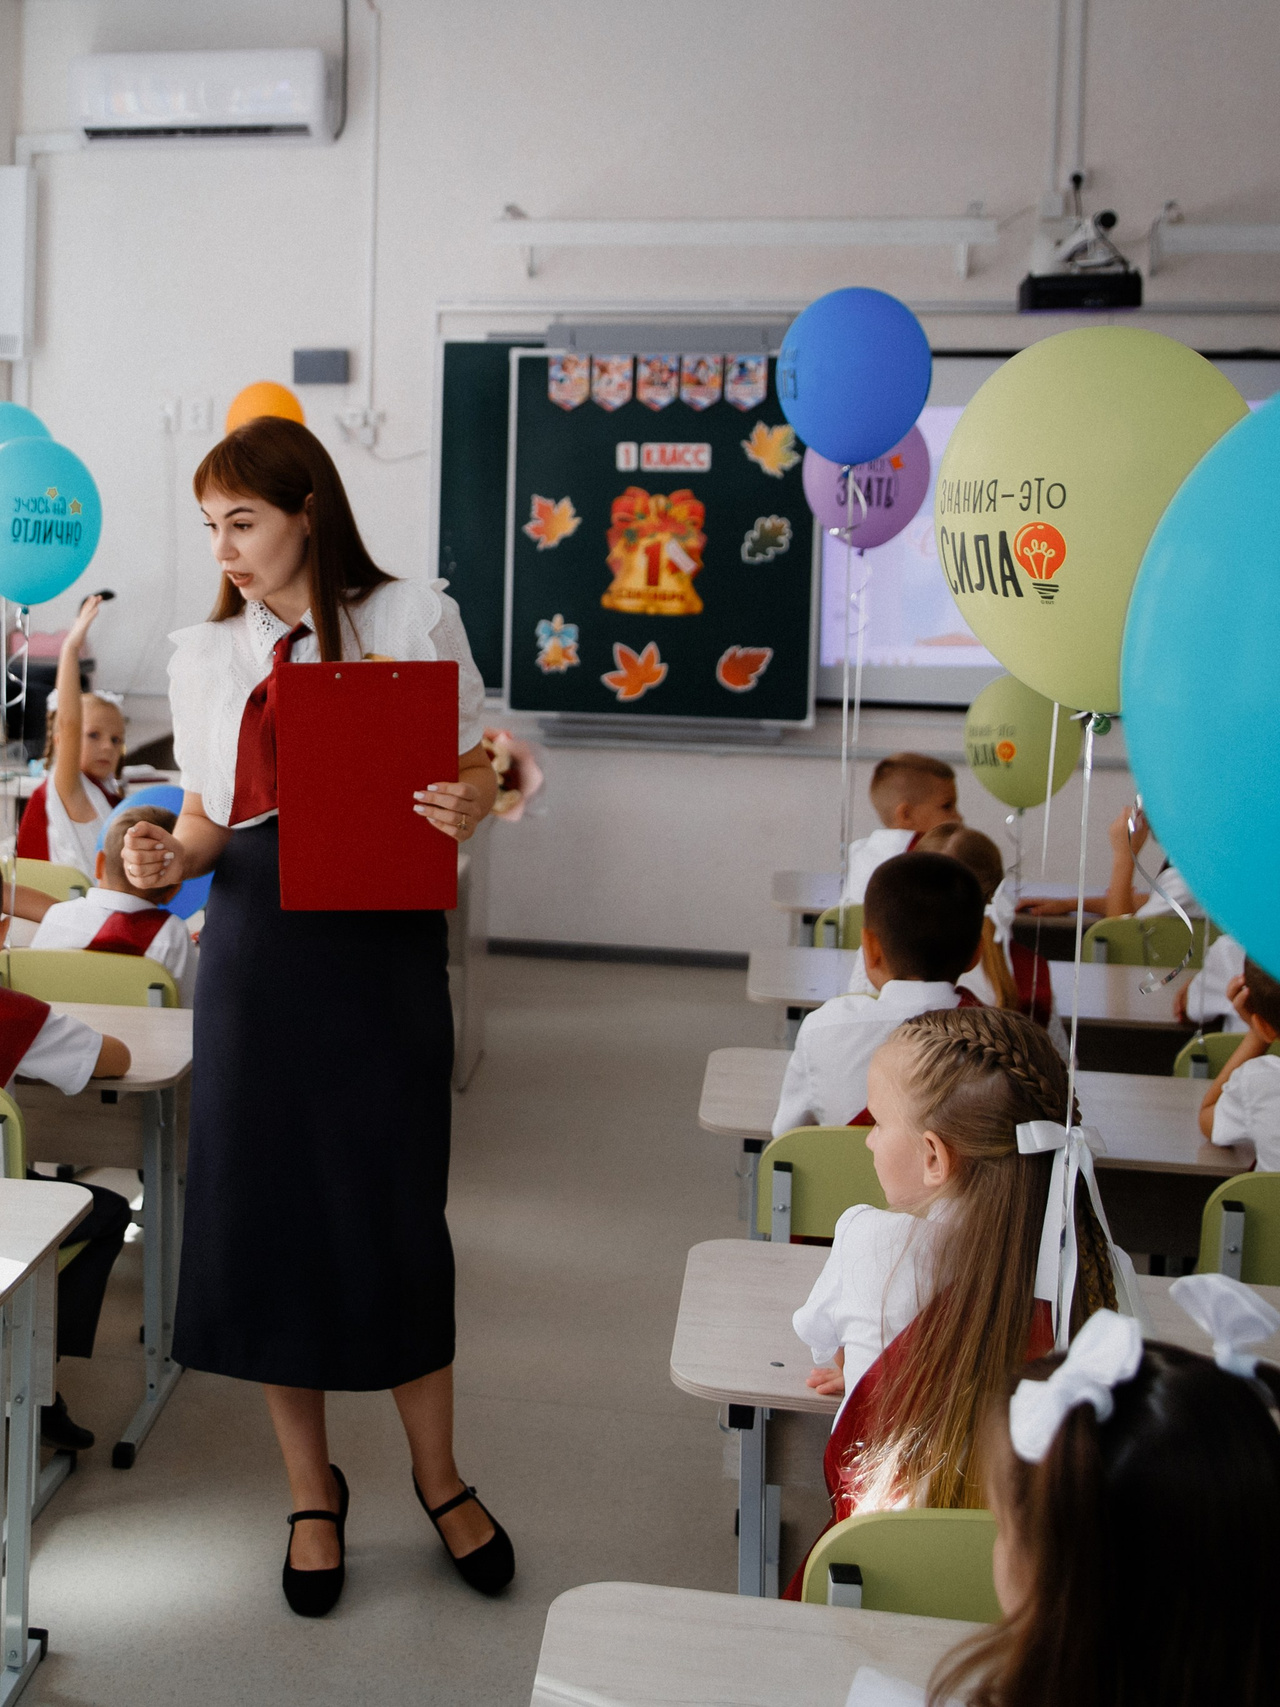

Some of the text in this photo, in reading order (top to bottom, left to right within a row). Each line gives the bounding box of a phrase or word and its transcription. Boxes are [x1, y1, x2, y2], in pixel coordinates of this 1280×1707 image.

[642, 446, 707, 468] КЛАСС
[11, 517, 84, 547] ОТЛИЧНО
[644, 541, 661, 587] 1
[940, 525, 1025, 598] СИЛА
